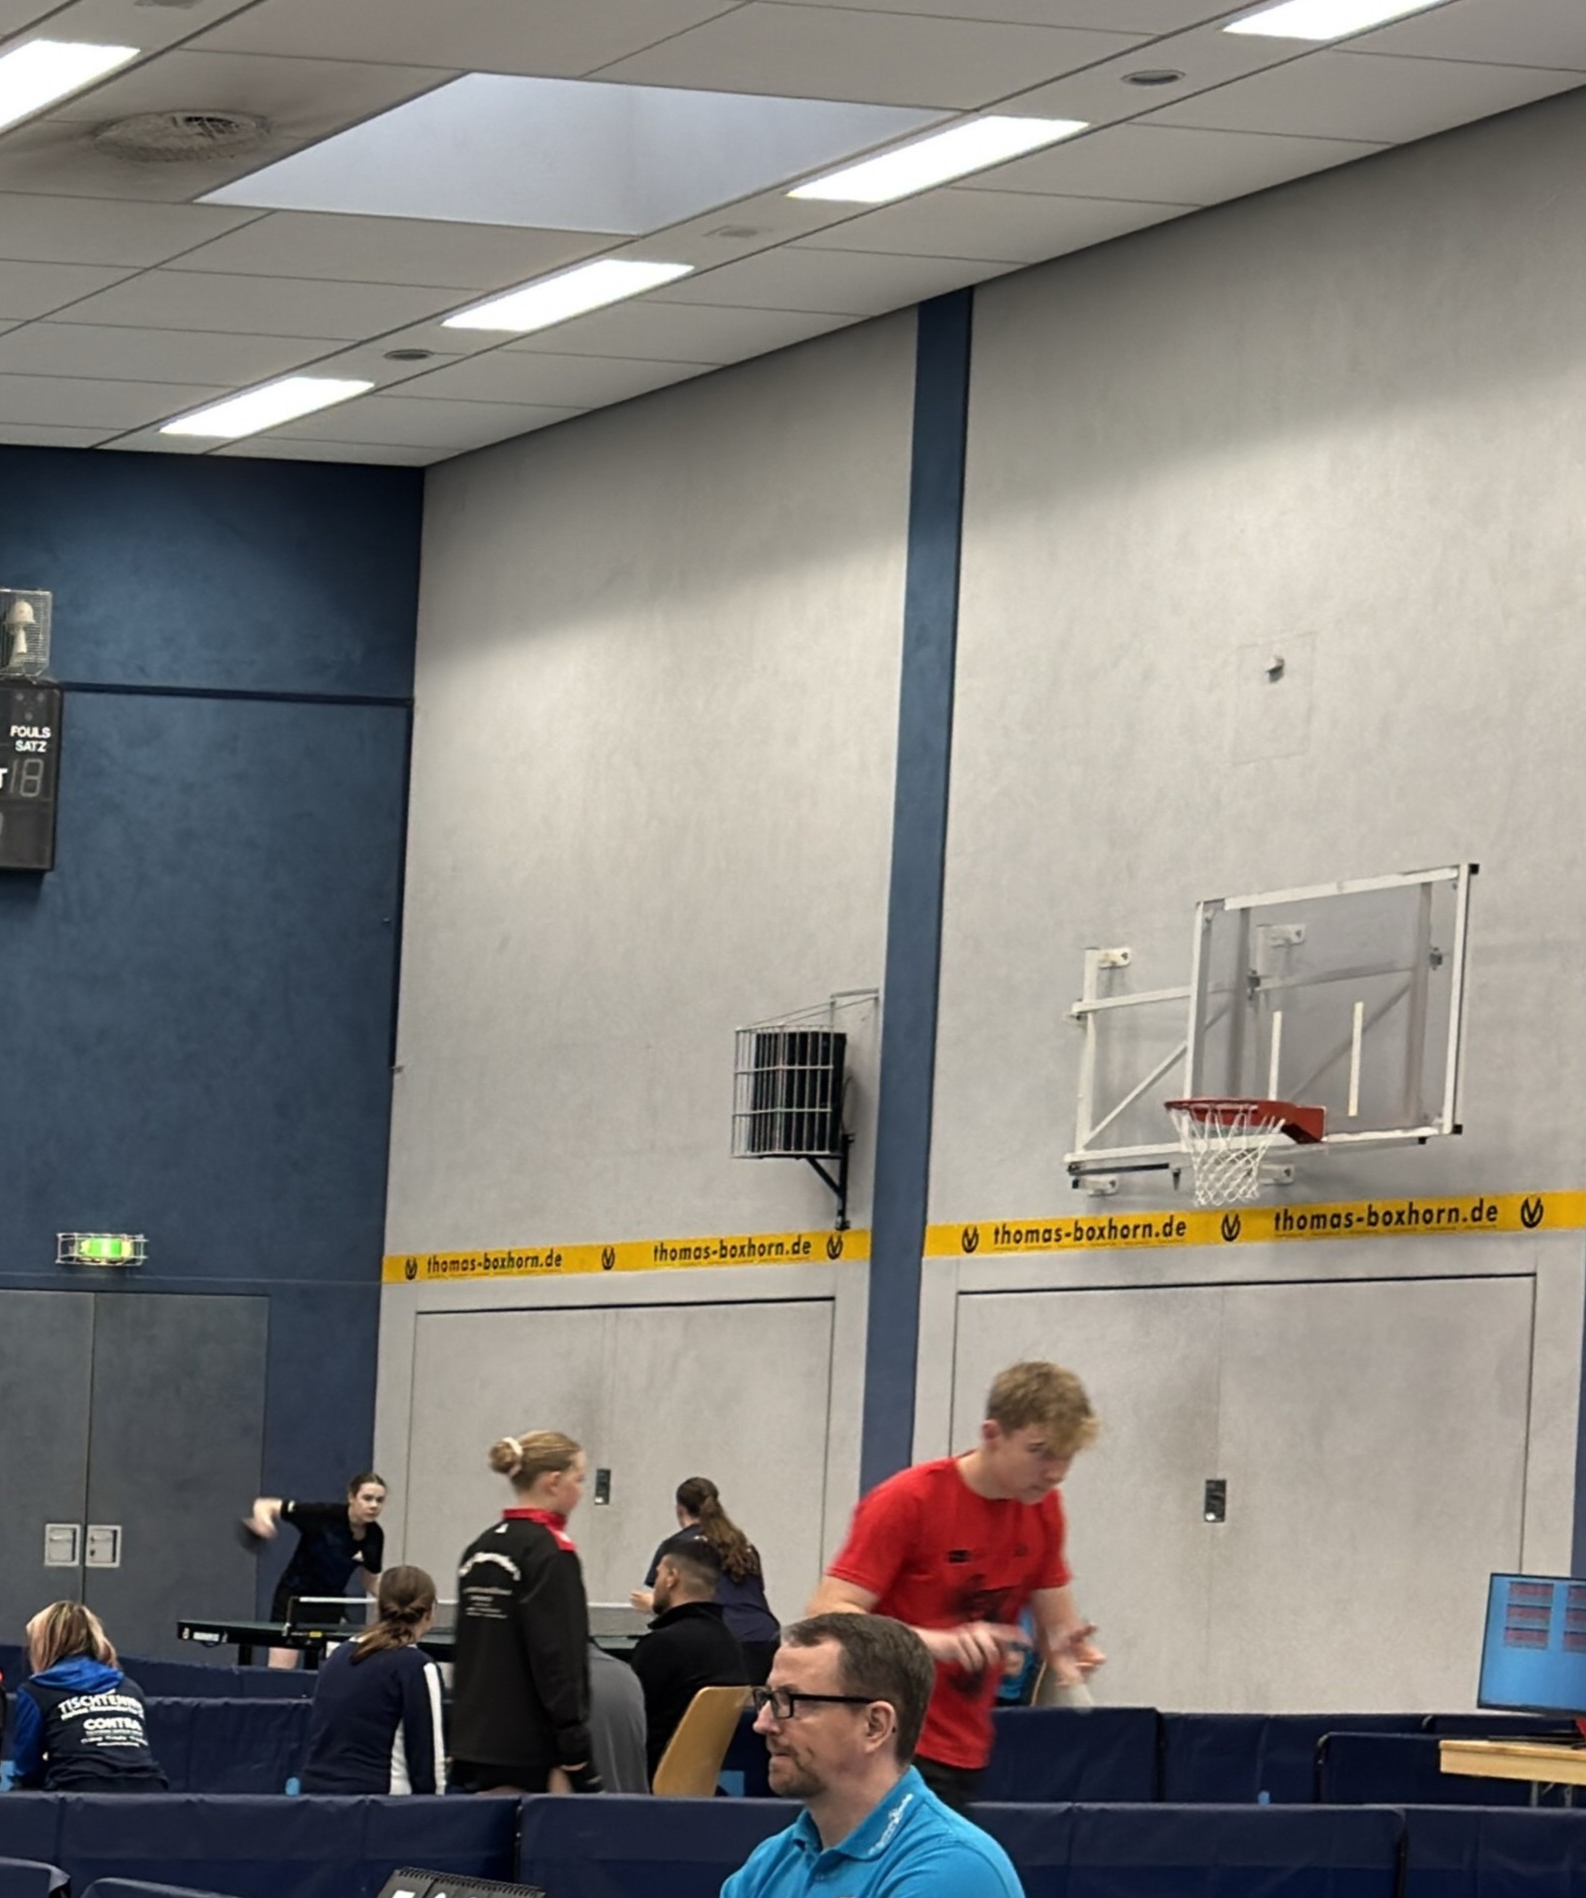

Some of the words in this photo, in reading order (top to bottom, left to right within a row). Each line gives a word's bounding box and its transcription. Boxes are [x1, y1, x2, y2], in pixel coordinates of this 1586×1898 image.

[10, 725, 51, 739] FOULS
[15, 739, 47, 752] SATZ
[993, 1217, 1187, 1246] thomas-boxhorn.de
[1273, 1199, 1499, 1232] thomas-boxhorn.de
[427, 1251, 563, 1273] thomas-boxhorn.de
[653, 1238, 812, 1262] thomas-boxhorn.de
